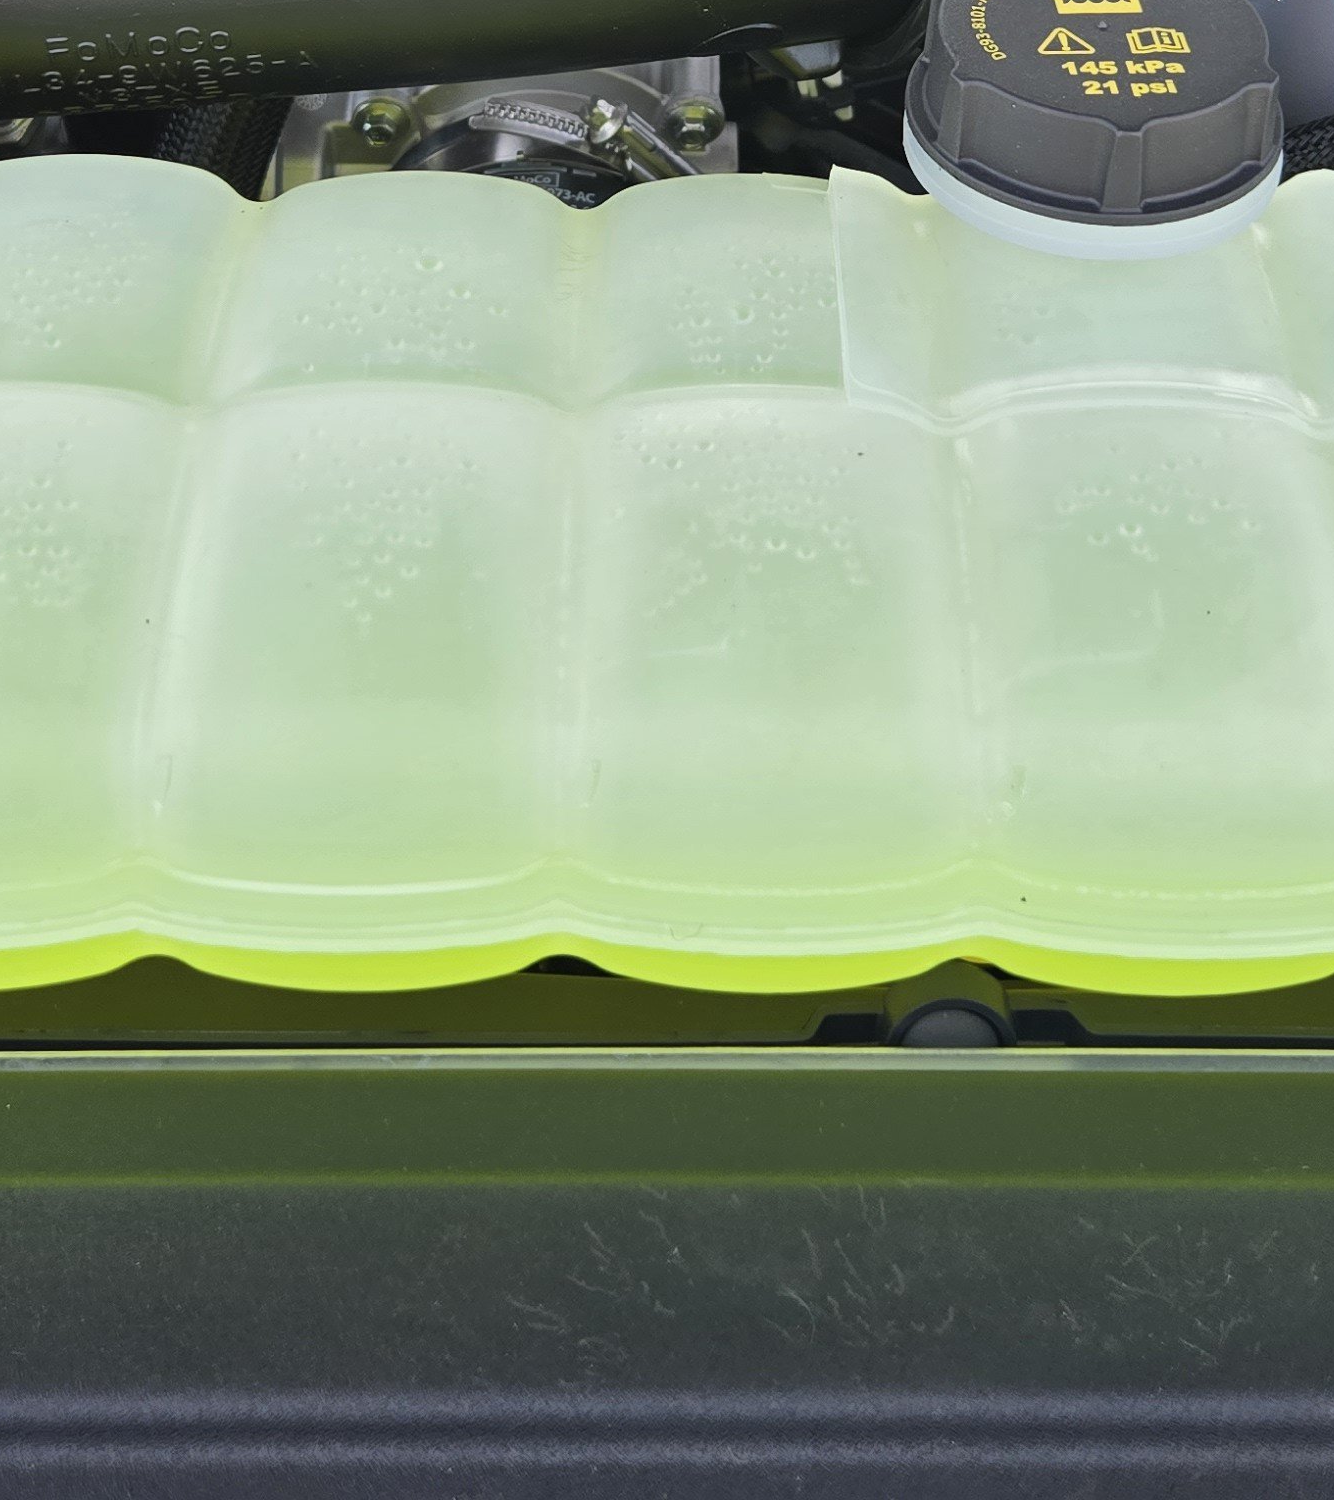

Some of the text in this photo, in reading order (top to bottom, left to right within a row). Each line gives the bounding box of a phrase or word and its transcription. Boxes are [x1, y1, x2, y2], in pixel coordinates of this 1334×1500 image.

[44, 26, 233, 61] FoMoCo
[1062, 60, 1186, 75] 145 kPa
[1082, 79, 1178, 97] 21 psi
